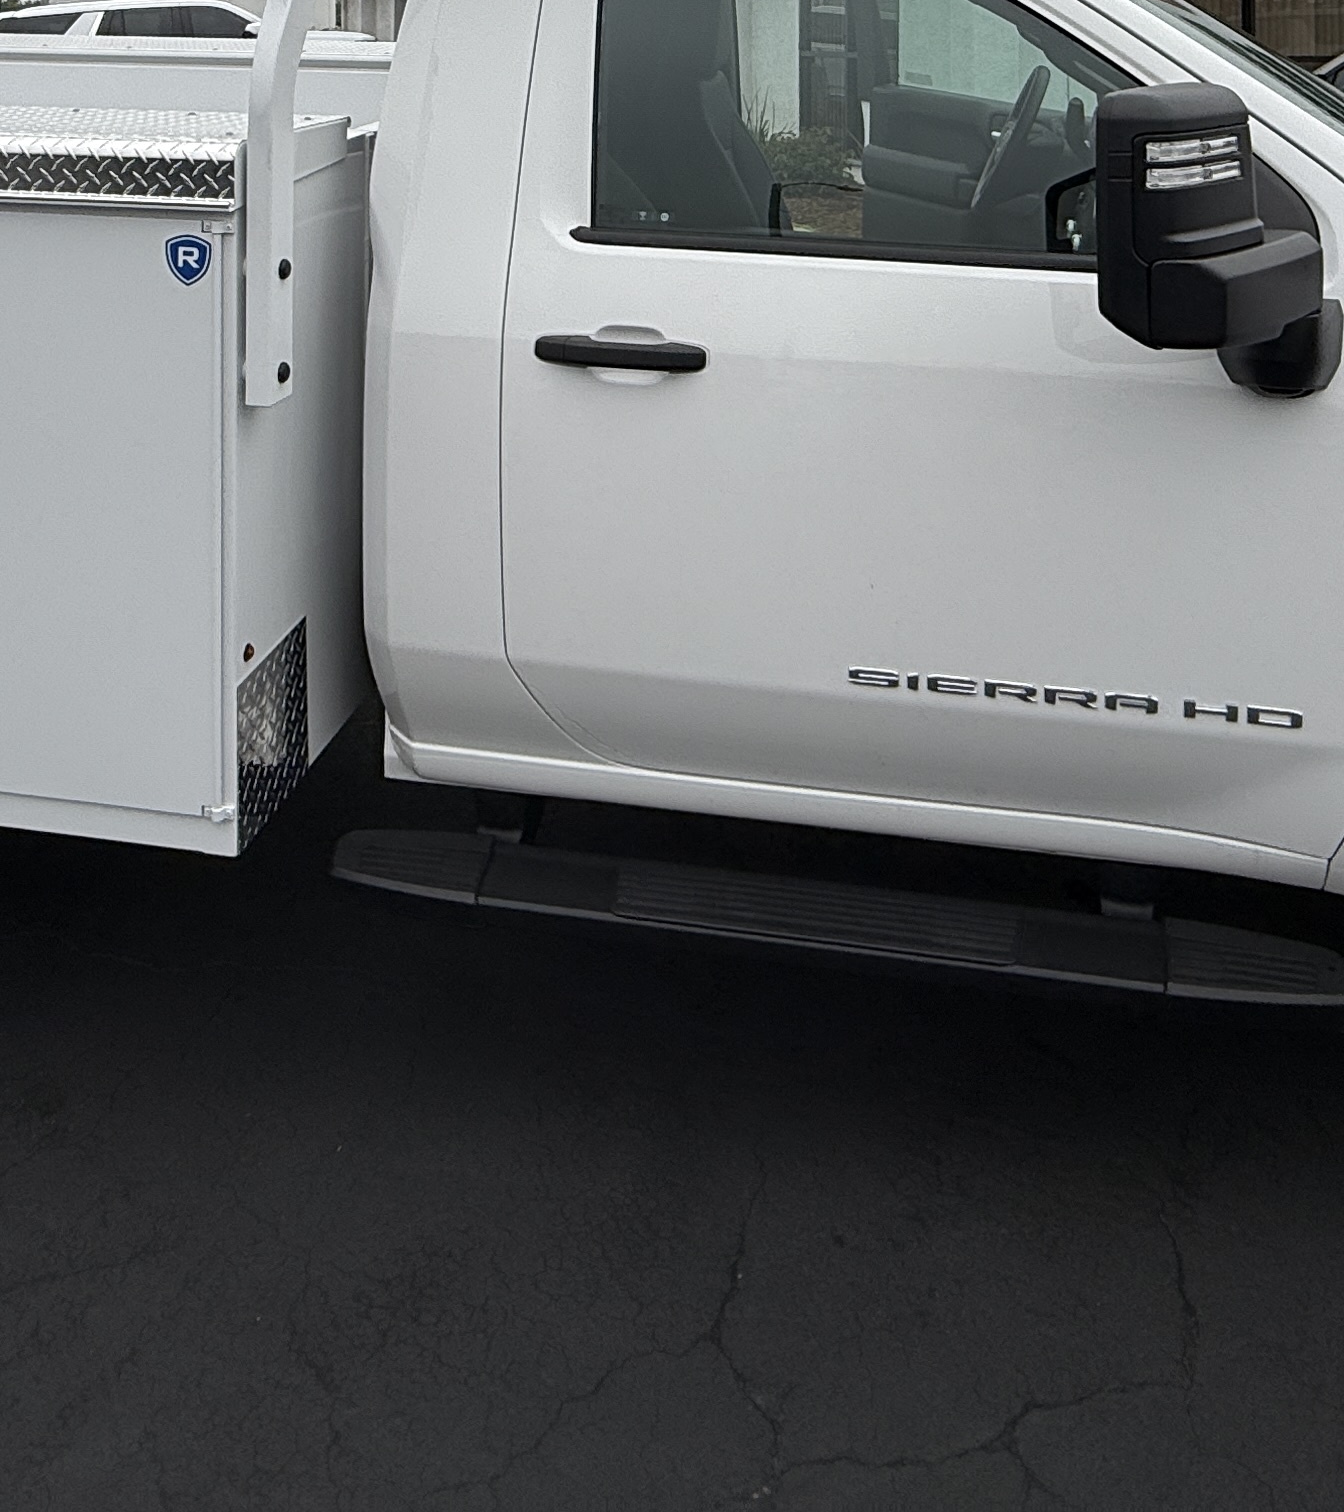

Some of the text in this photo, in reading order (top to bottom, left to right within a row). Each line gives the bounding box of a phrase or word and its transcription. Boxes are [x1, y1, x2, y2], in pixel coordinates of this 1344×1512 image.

[177, 246, 200, 269] R
[847, 665, 1304, 729] SIERRA HD
